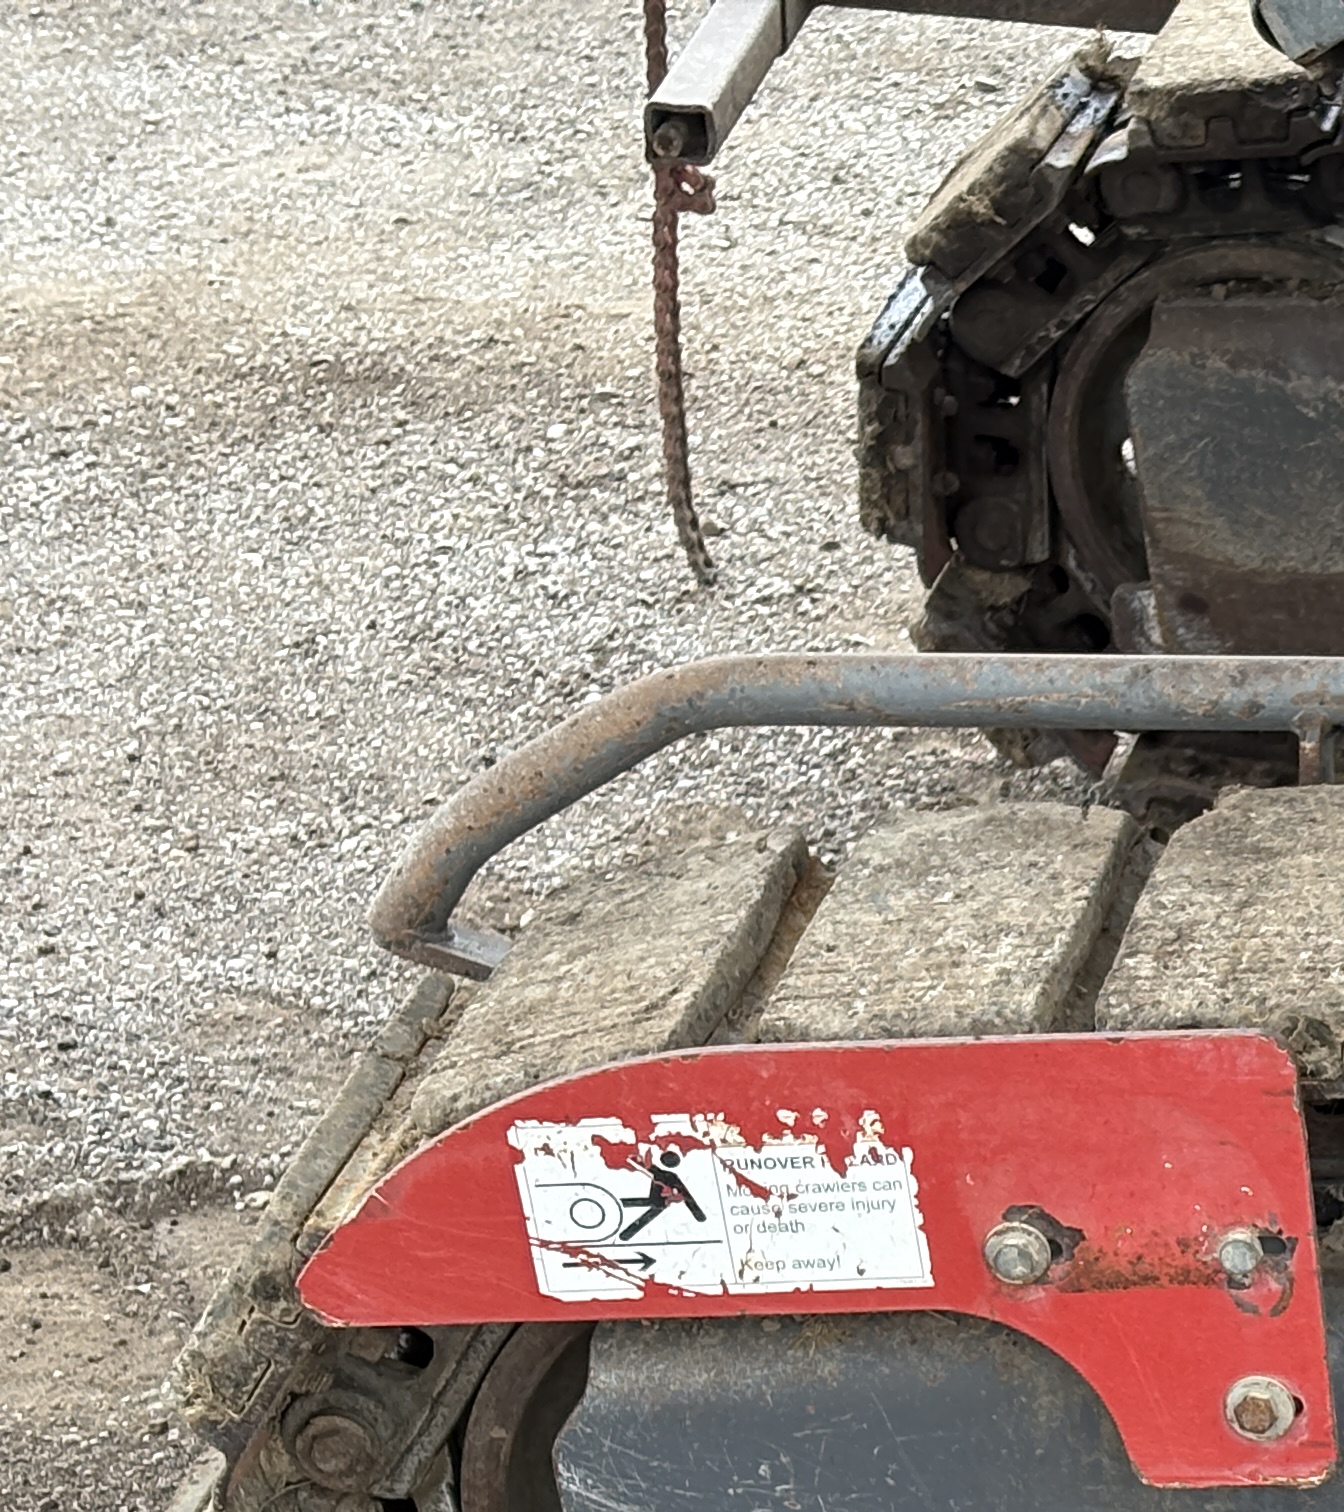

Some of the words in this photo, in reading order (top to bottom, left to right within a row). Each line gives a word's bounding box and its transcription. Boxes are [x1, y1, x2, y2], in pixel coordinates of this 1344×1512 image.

[721, 1156, 815, 1174] RUNOVER
[796, 1181, 867, 1194] crawlers
[872, 1179, 902, 1191] can
[730, 1204, 781, 1216] cause
[788, 1200, 845, 1213] severe
[851, 1198, 896, 1214] injury
[733, 1223, 749, 1234] or
[757, 1219, 805, 1234] death
[741, 1257, 785, 1273] Keep
[792, 1255, 840, 1271] away!
